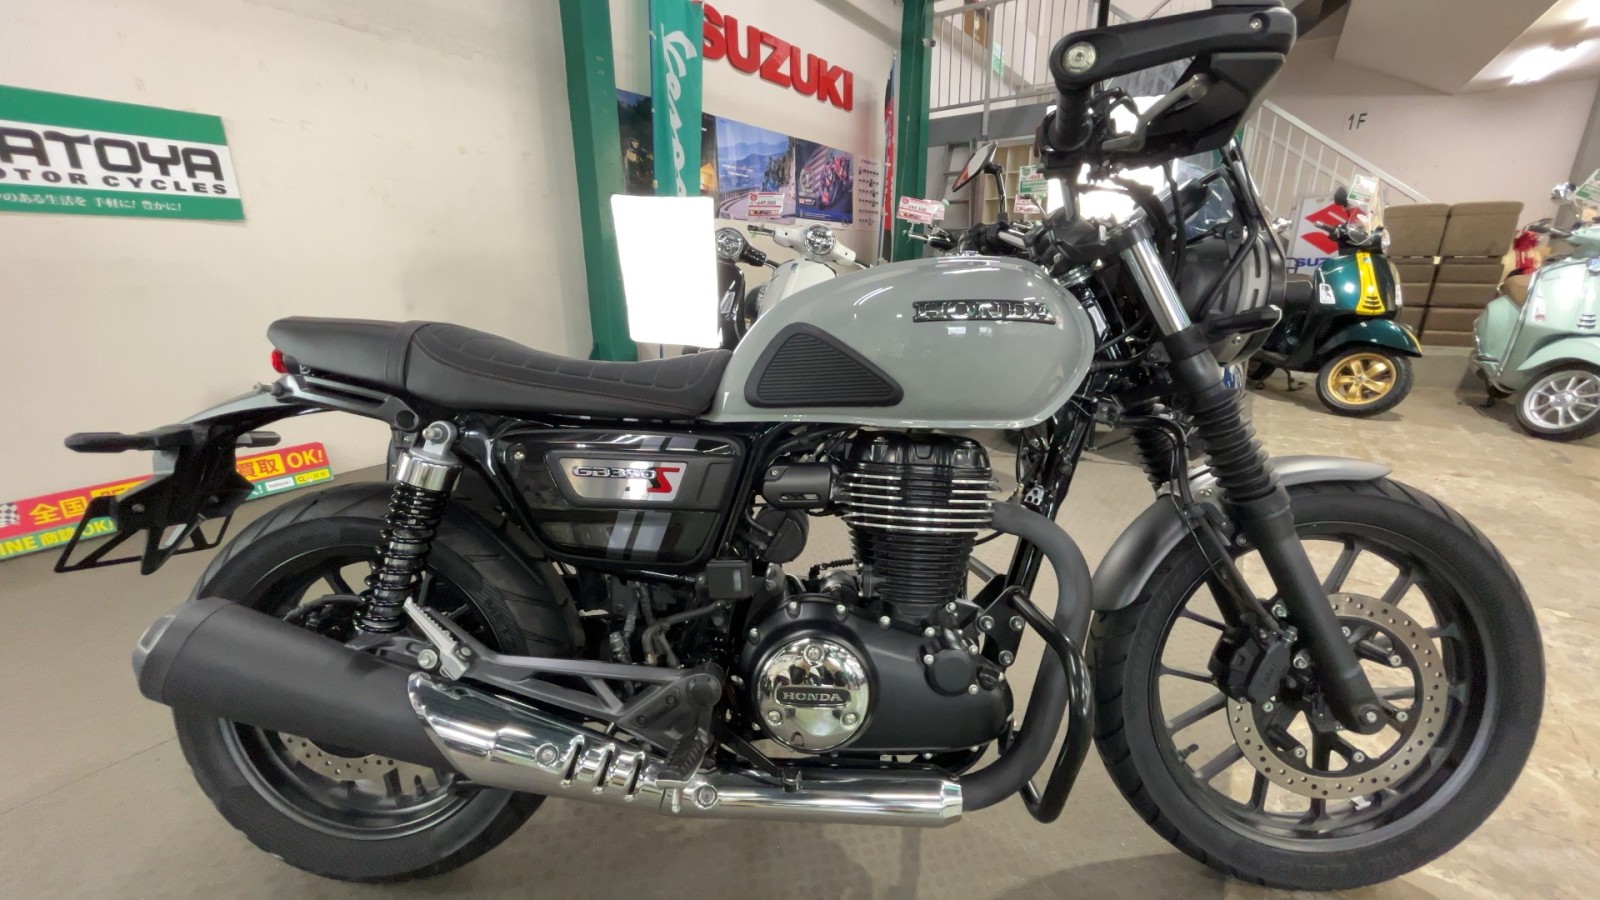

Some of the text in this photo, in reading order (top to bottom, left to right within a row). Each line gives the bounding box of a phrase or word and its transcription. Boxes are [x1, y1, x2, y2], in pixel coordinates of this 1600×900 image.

[703, 3, 853, 111] SUZUKI
[1347, 112, 1368, 130] 1F
[102, 175, 228, 195] CYCLES
[913, 301, 1054, 323] HONDA
[286, 448, 323, 469] OK!
[28, 495, 89, 526] 全国
[781, 691, 843, 702] HONDA
